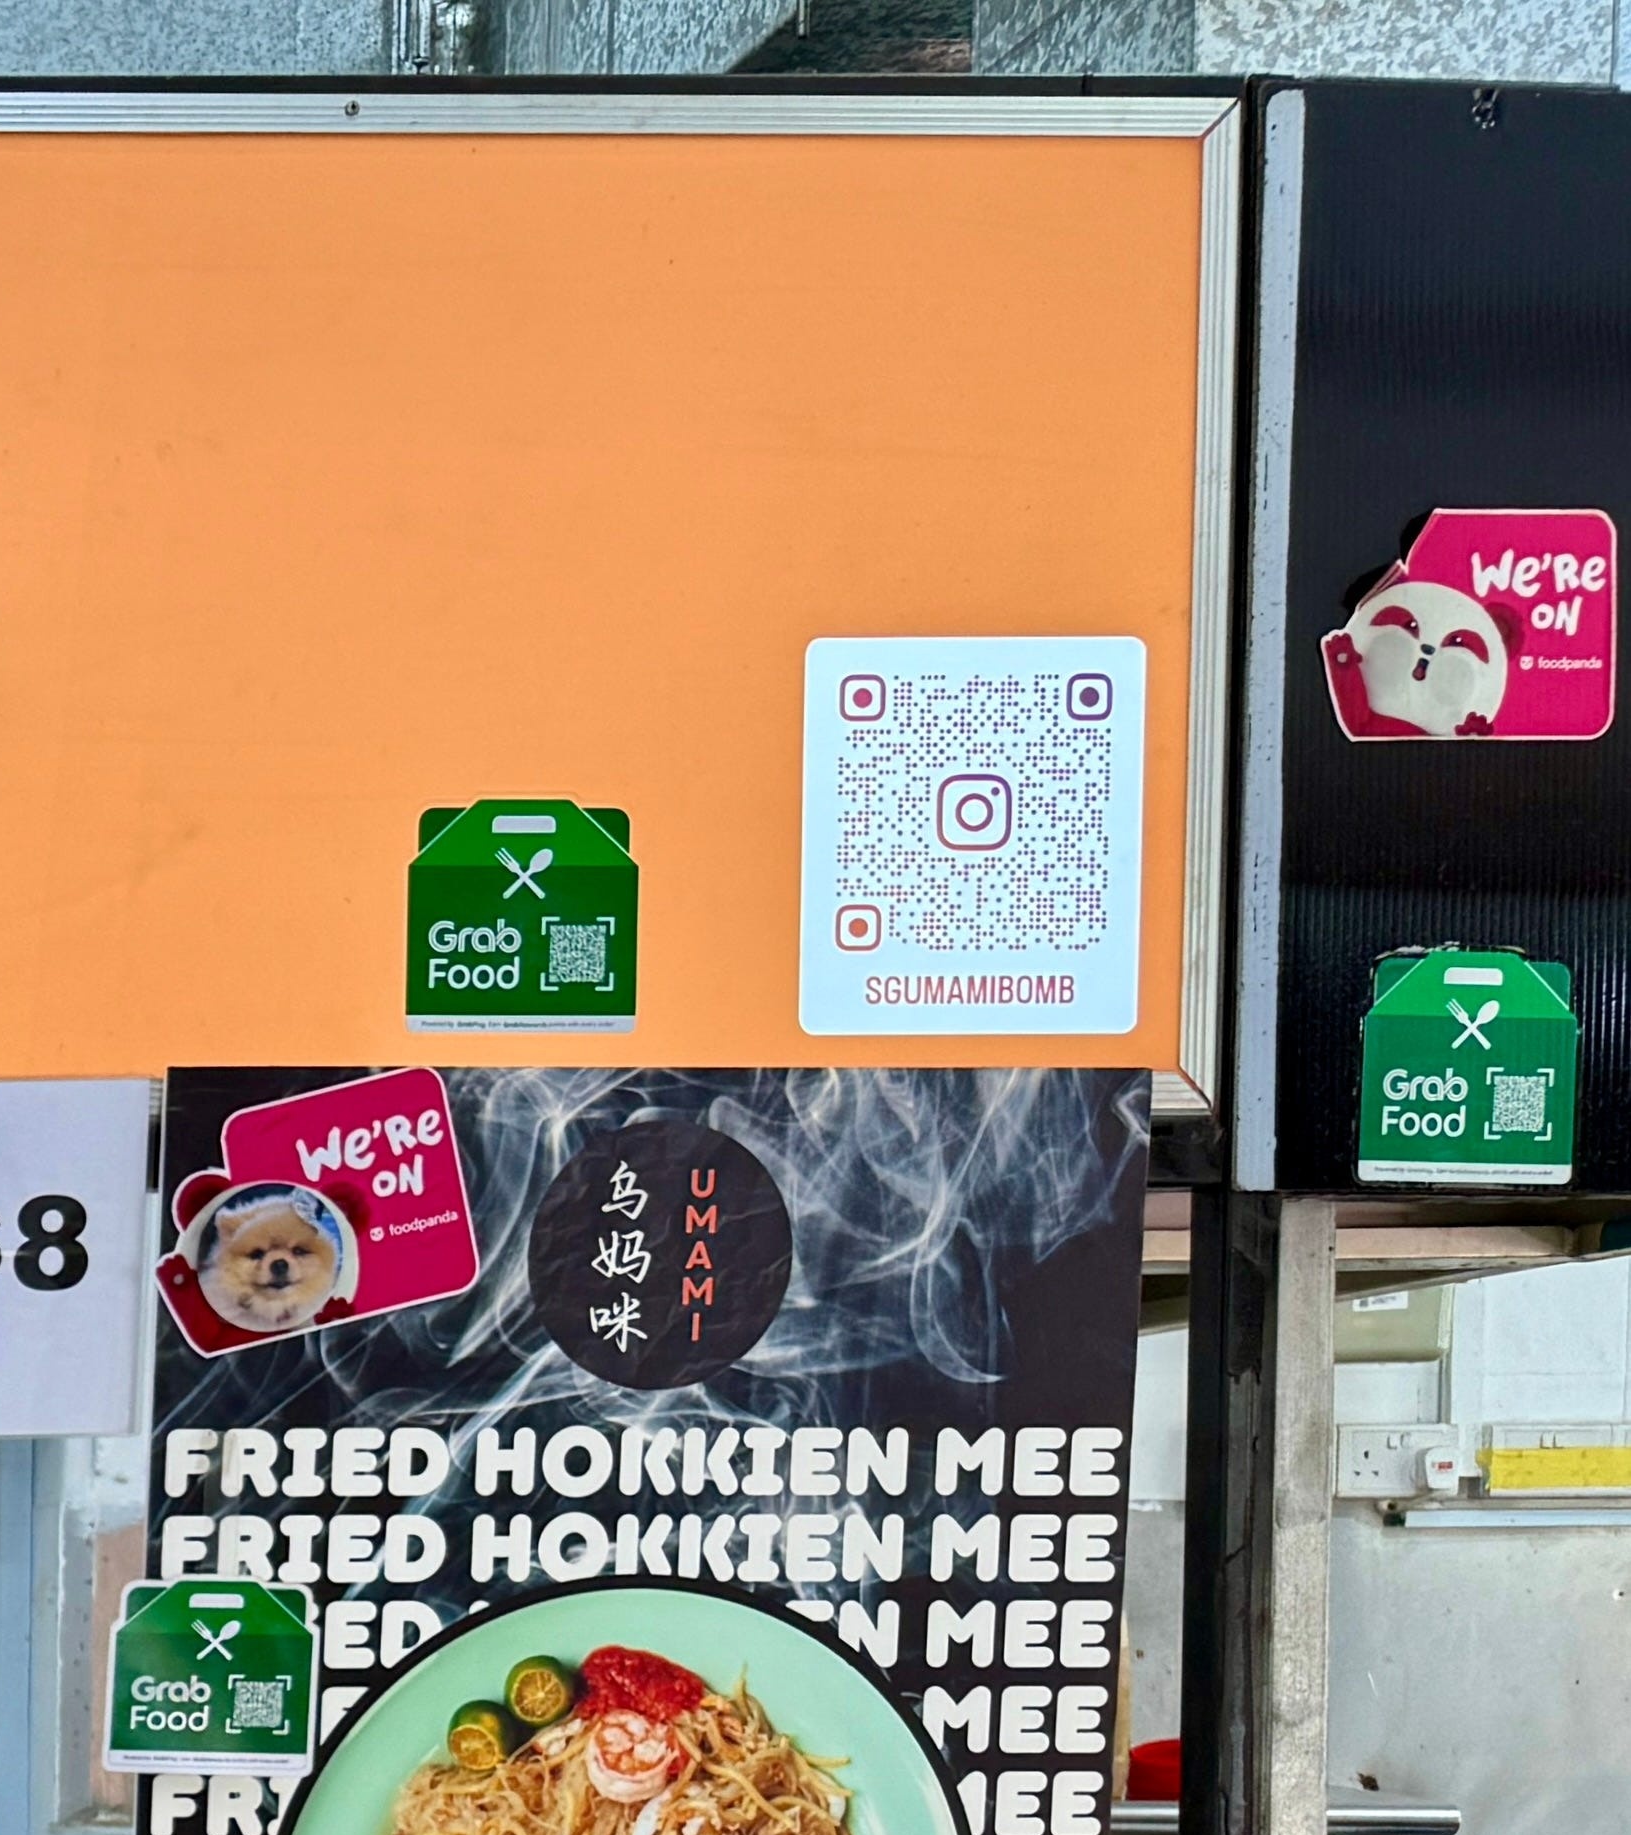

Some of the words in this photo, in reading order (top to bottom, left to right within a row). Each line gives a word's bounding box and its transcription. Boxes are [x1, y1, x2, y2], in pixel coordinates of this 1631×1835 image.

[1537, 656, 1603, 671] foodpanda
[428, 919, 522, 955] Grab
[428, 957, 520, 991] Food
[865, 975, 1075, 1005] SGUMAMIBOMB
[1383, 1067, 1468, 1102] Grab
[1381, 1105, 1466, 1137] Food
[388, 1209, 458, 1237] foodpanda
[589, 1160, 652, 1353] 乌妈咪
[681, 1168, 718, 1342] UMAMI
[165, 1427, 450, 1497] FRIED
[474, 1425, 909, 1497] HOKKIEN
[935, 1427, 1123, 1497] MEE
[161, 1514, 446, 1583] FRIED
[471, 1511, 904, 1583] HOKKIEN
[930, 1513, 1118, 1583] MEE
[926, 1600, 1113, 1668] MEE
[130, 1674, 212, 1703] Grab
[129, 1705, 210, 1732] Food
[922, 1686, 1109, 1754] MEE
